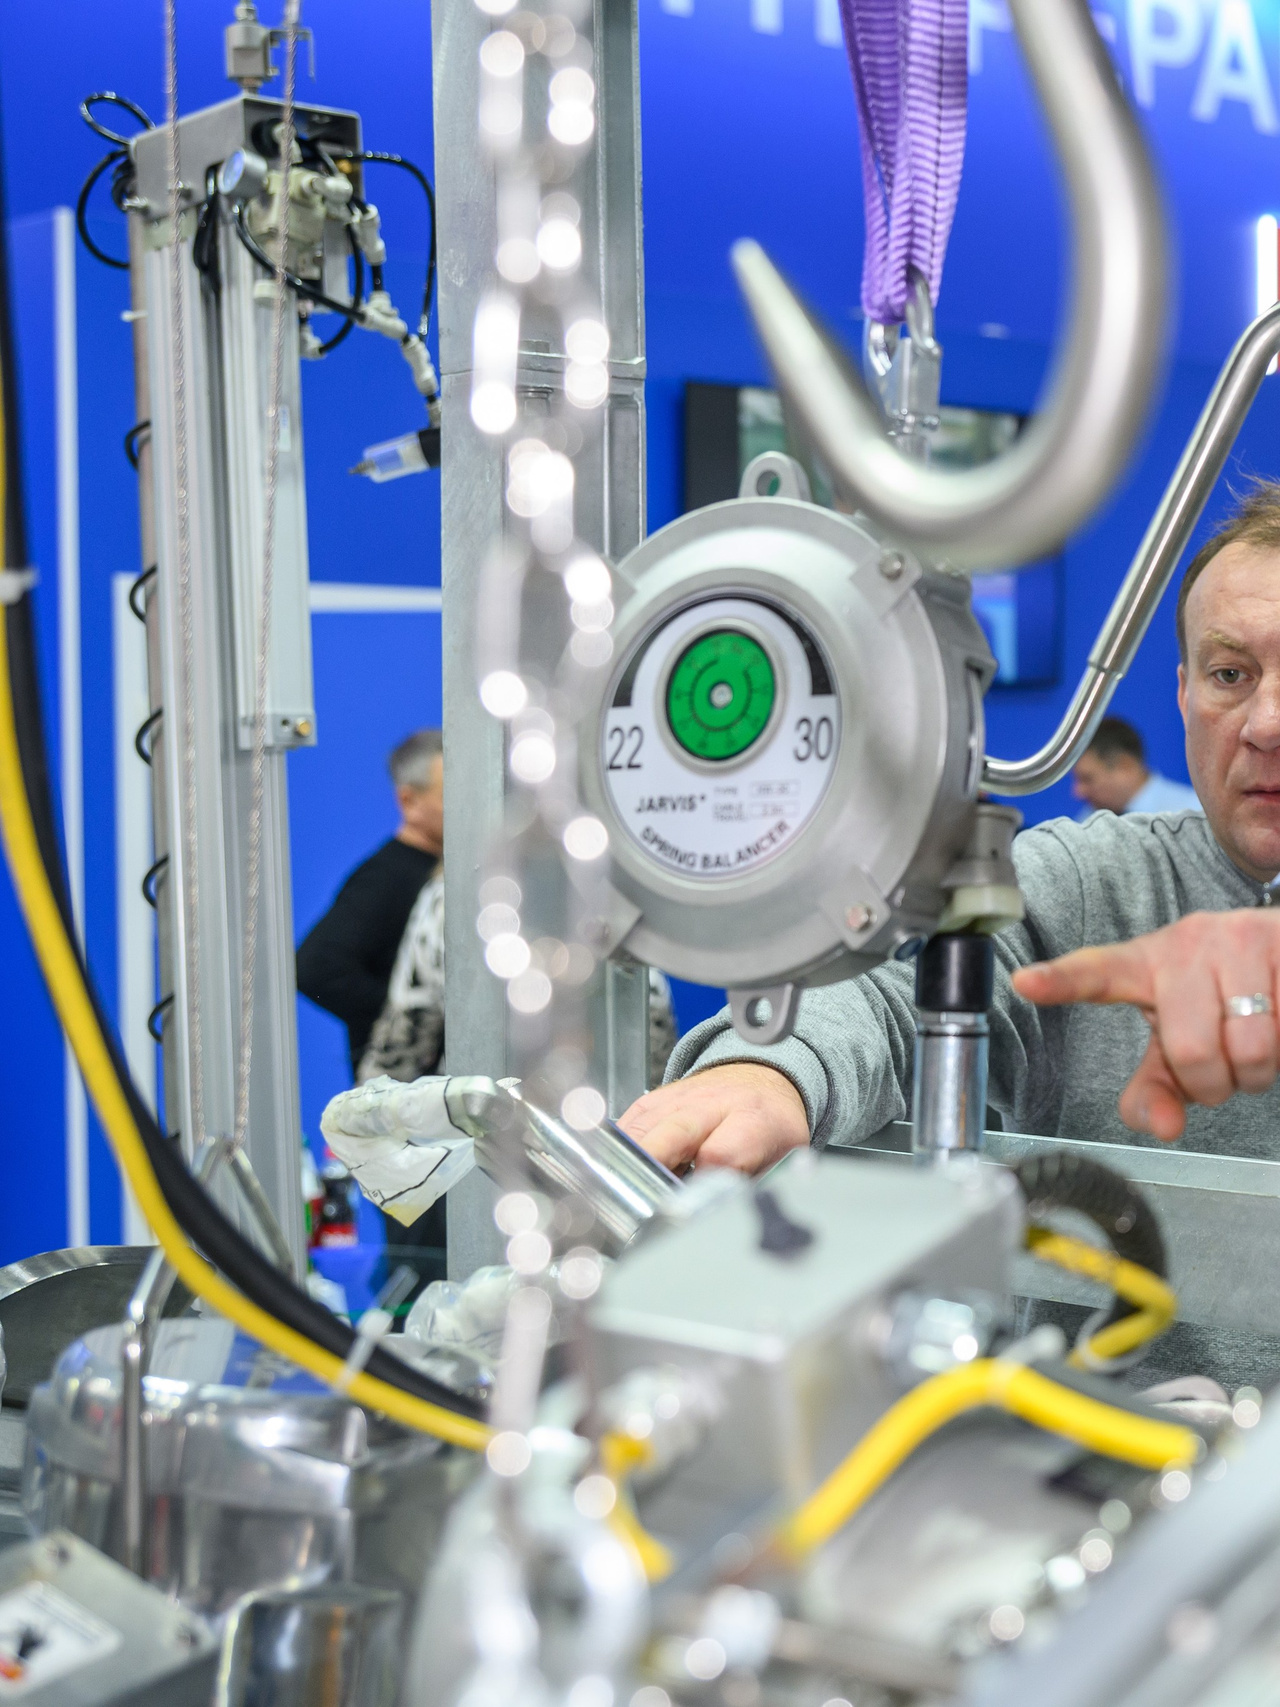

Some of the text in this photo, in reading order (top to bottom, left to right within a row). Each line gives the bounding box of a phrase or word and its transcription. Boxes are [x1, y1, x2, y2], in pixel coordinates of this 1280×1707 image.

[606, 725, 644, 771] 22
[792, 715, 834, 763] 30
[635, 795, 698, 813] JARVIS
[640, 819, 791, 869] SPRING BALANCER
